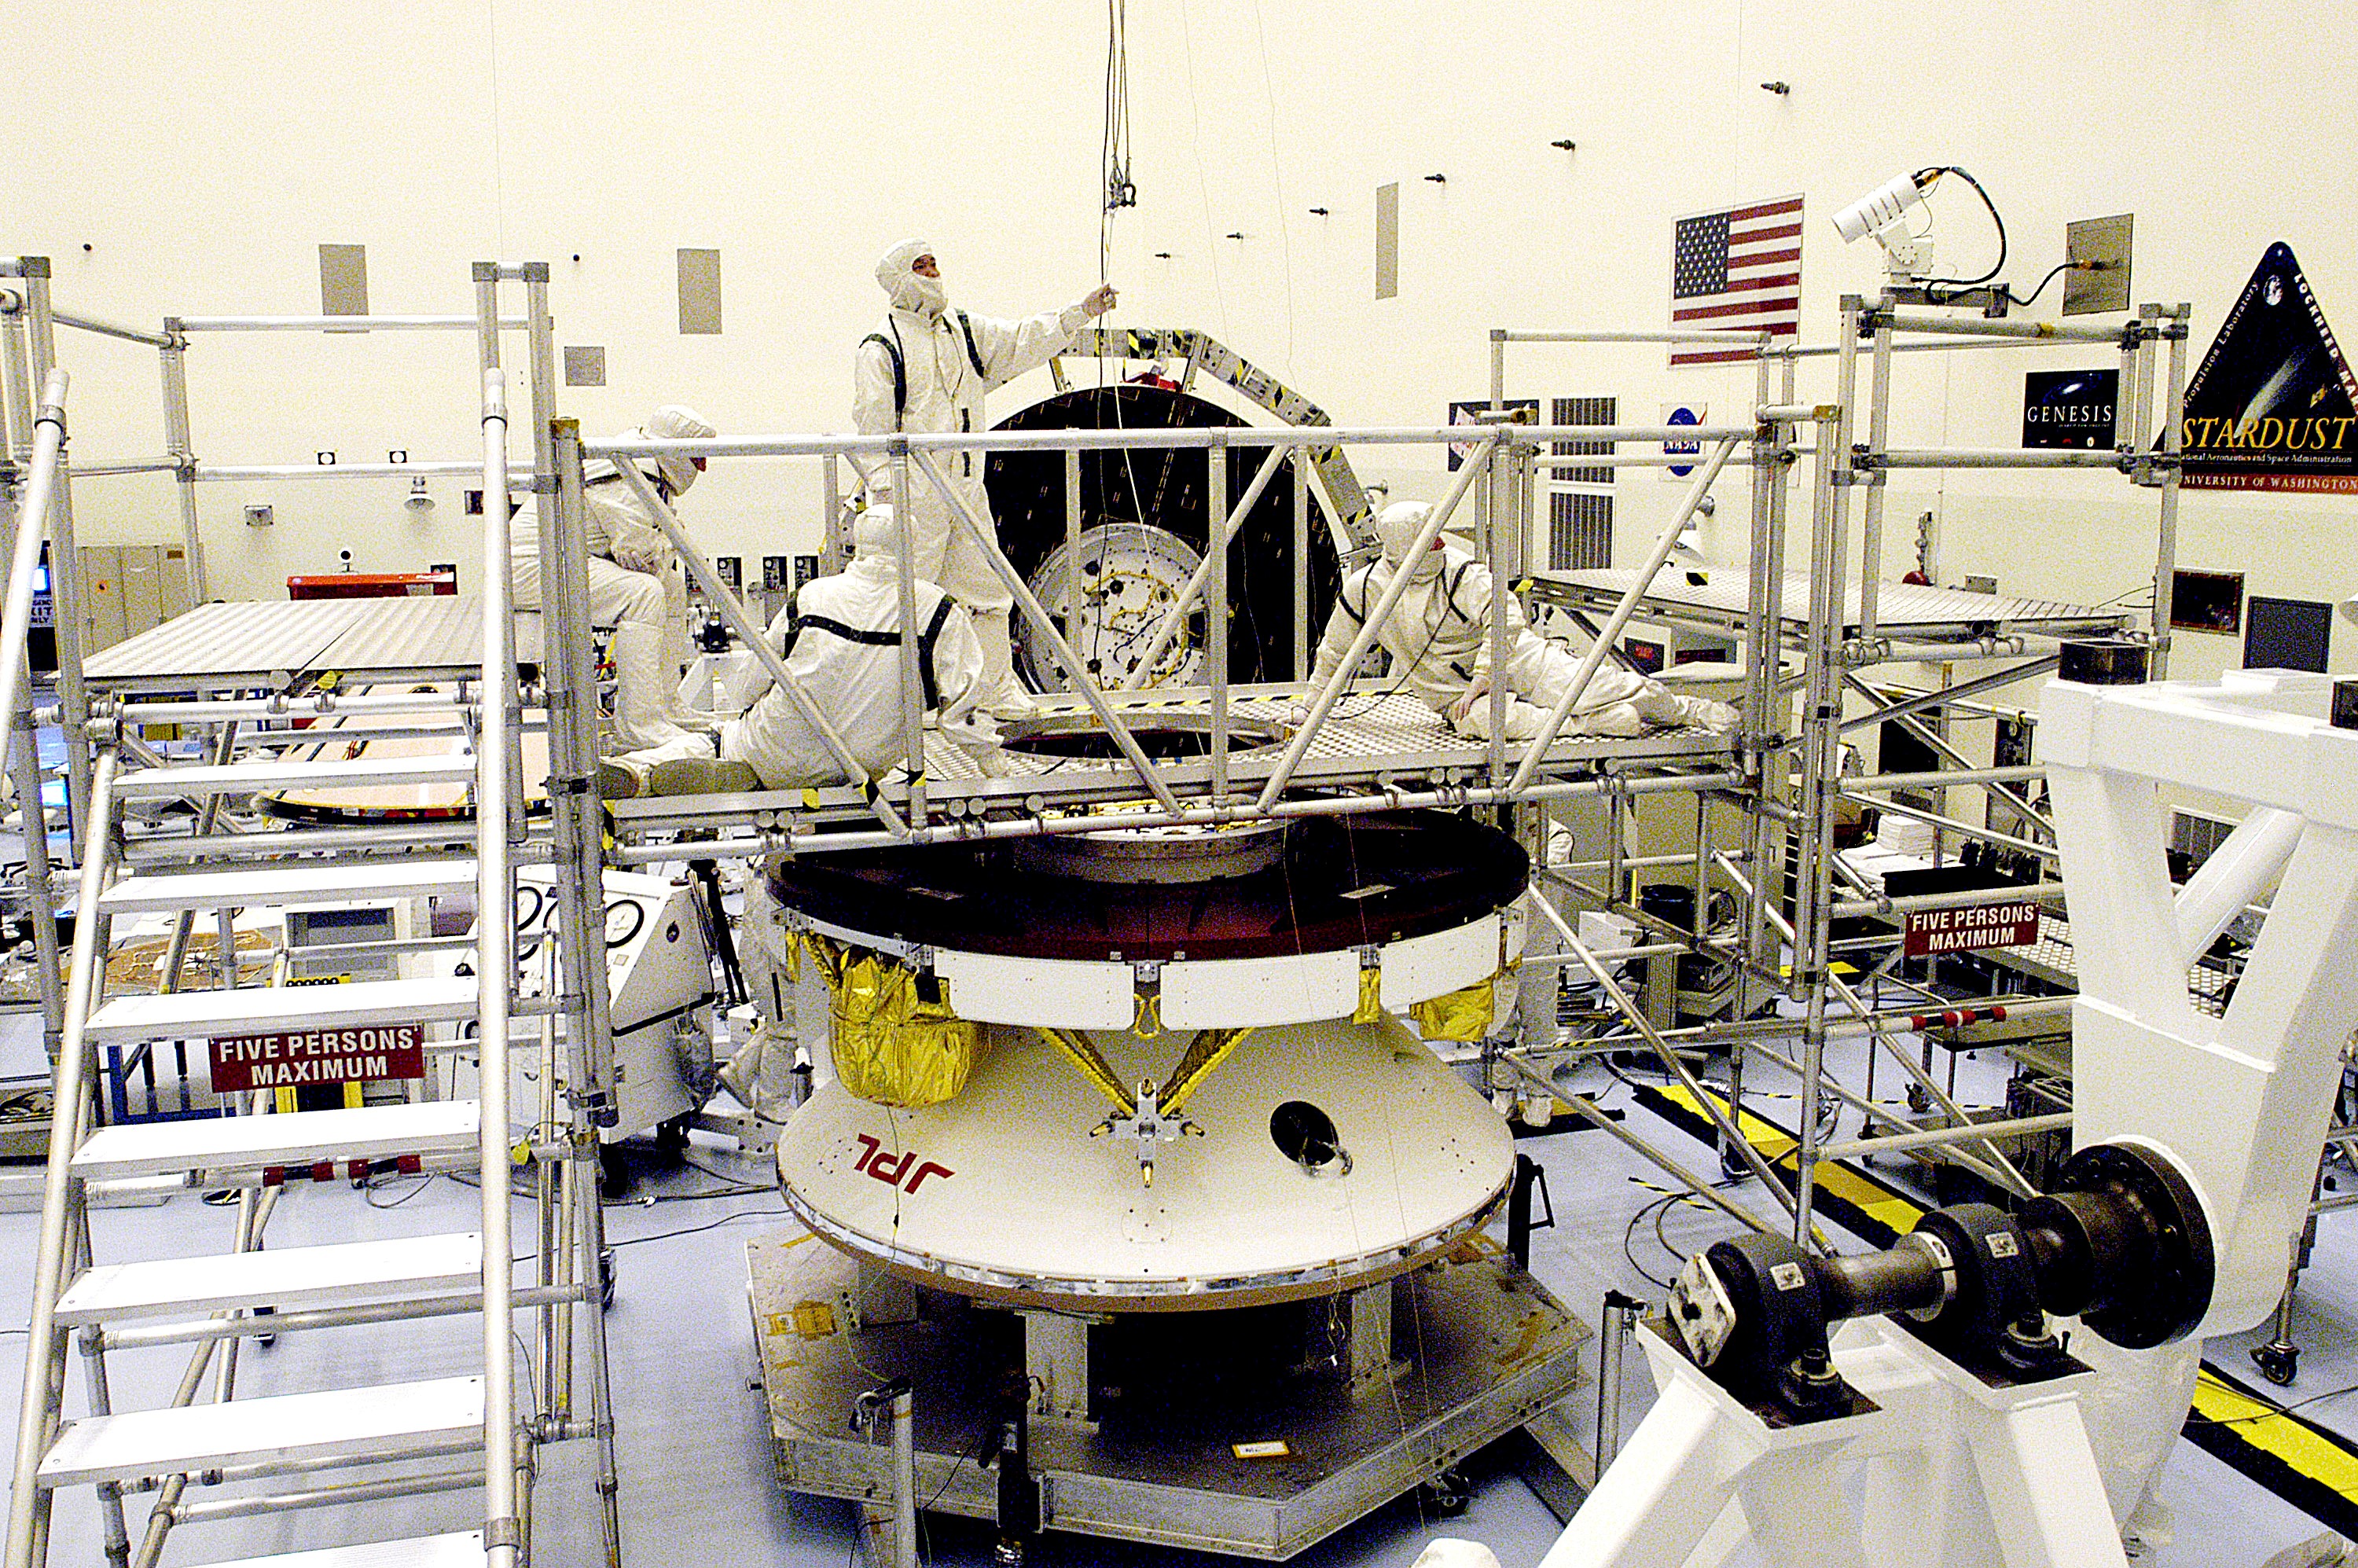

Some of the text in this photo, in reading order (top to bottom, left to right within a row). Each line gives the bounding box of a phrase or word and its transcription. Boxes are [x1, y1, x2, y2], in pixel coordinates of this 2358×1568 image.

[2294, 273, 2339, 358] LOCKHEED
[2183, 281, 2258, 408] Propulsion Laboratory
[2027, 405, 2111, 422] GENESIS
[2181, 416, 2356, 450] STARDUST
[2181, 453, 2352, 465] ational Aeronautics and Space Administration
[2184, 476, 2358, 490] NIVERSITY OF WASHINGTON
[1912, 905, 2034, 932] FIVE PERSONS
[1929, 927, 2015, 951] MAXIMUM
[219, 1028, 413, 1063] FIVE PERSONS
[251, 1056, 388, 1086] MAXIMUM
[854, 1133, 956, 1195] JPL
